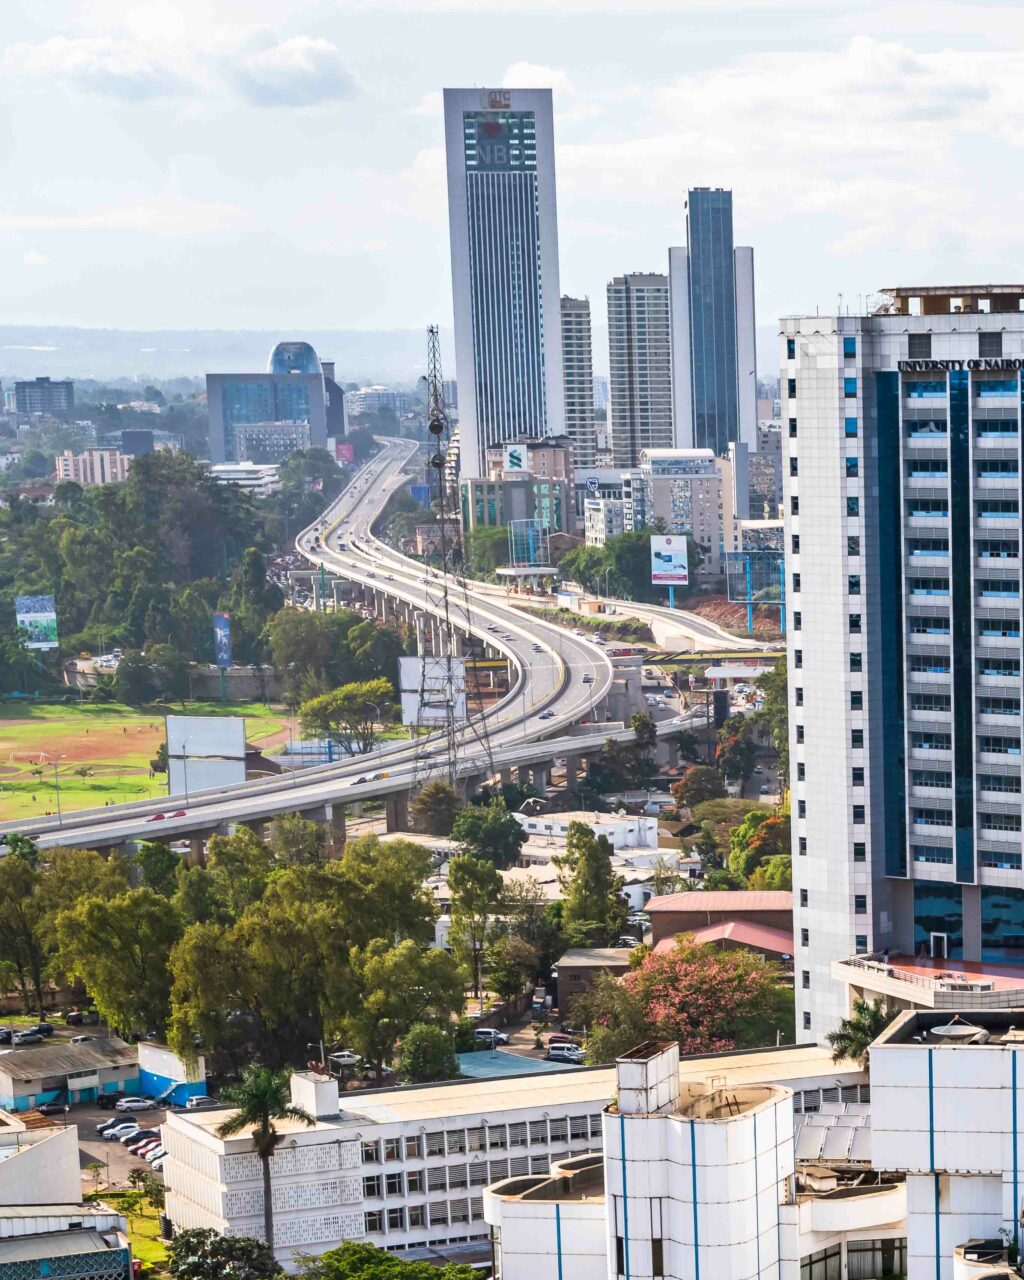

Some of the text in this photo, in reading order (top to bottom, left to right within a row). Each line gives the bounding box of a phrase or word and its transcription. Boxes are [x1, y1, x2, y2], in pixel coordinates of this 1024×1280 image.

[489, 91, 510, 100] GTC
[897, 360, 966, 372] UNIVERSITY
[967, 359, 984, 370] OF
